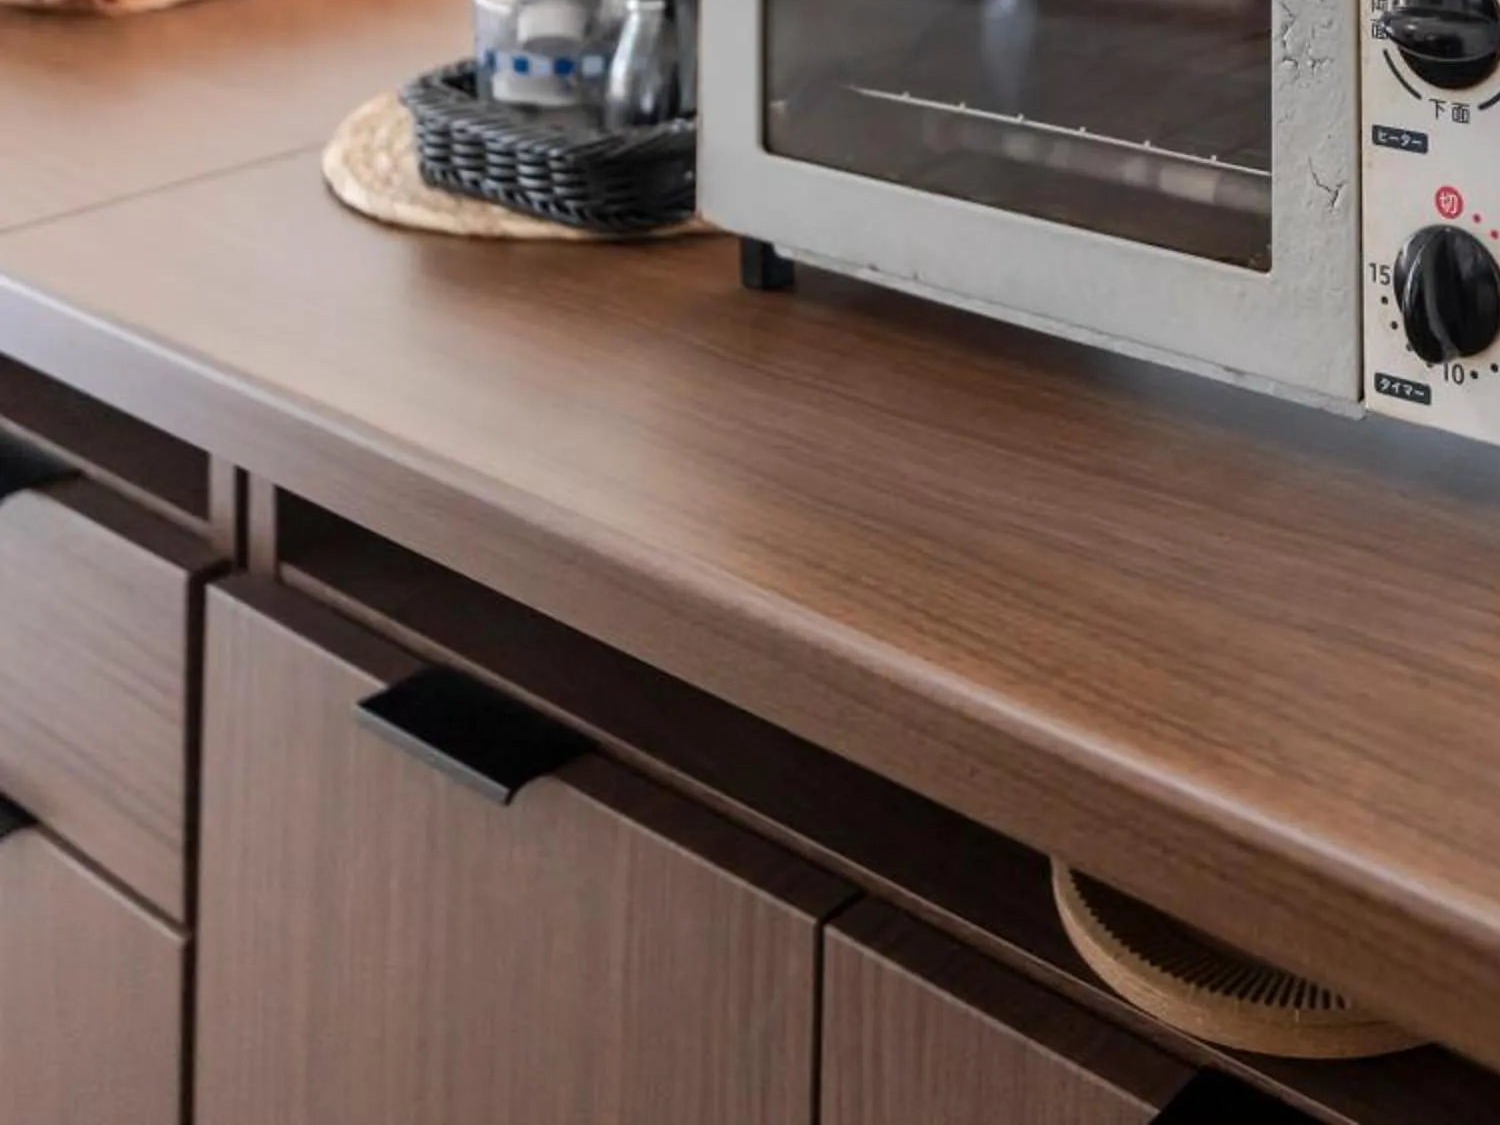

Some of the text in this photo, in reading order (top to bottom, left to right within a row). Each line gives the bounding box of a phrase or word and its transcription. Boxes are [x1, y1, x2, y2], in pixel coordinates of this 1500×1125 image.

[1429, 97, 1471, 124] 下面
[1376, 128, 1424, 148] ヒーター
[1369, 262, 1391, 286] 15
[1443, 363, 1466, 386] 10
[1378, 379, 1426, 399] タイマー
